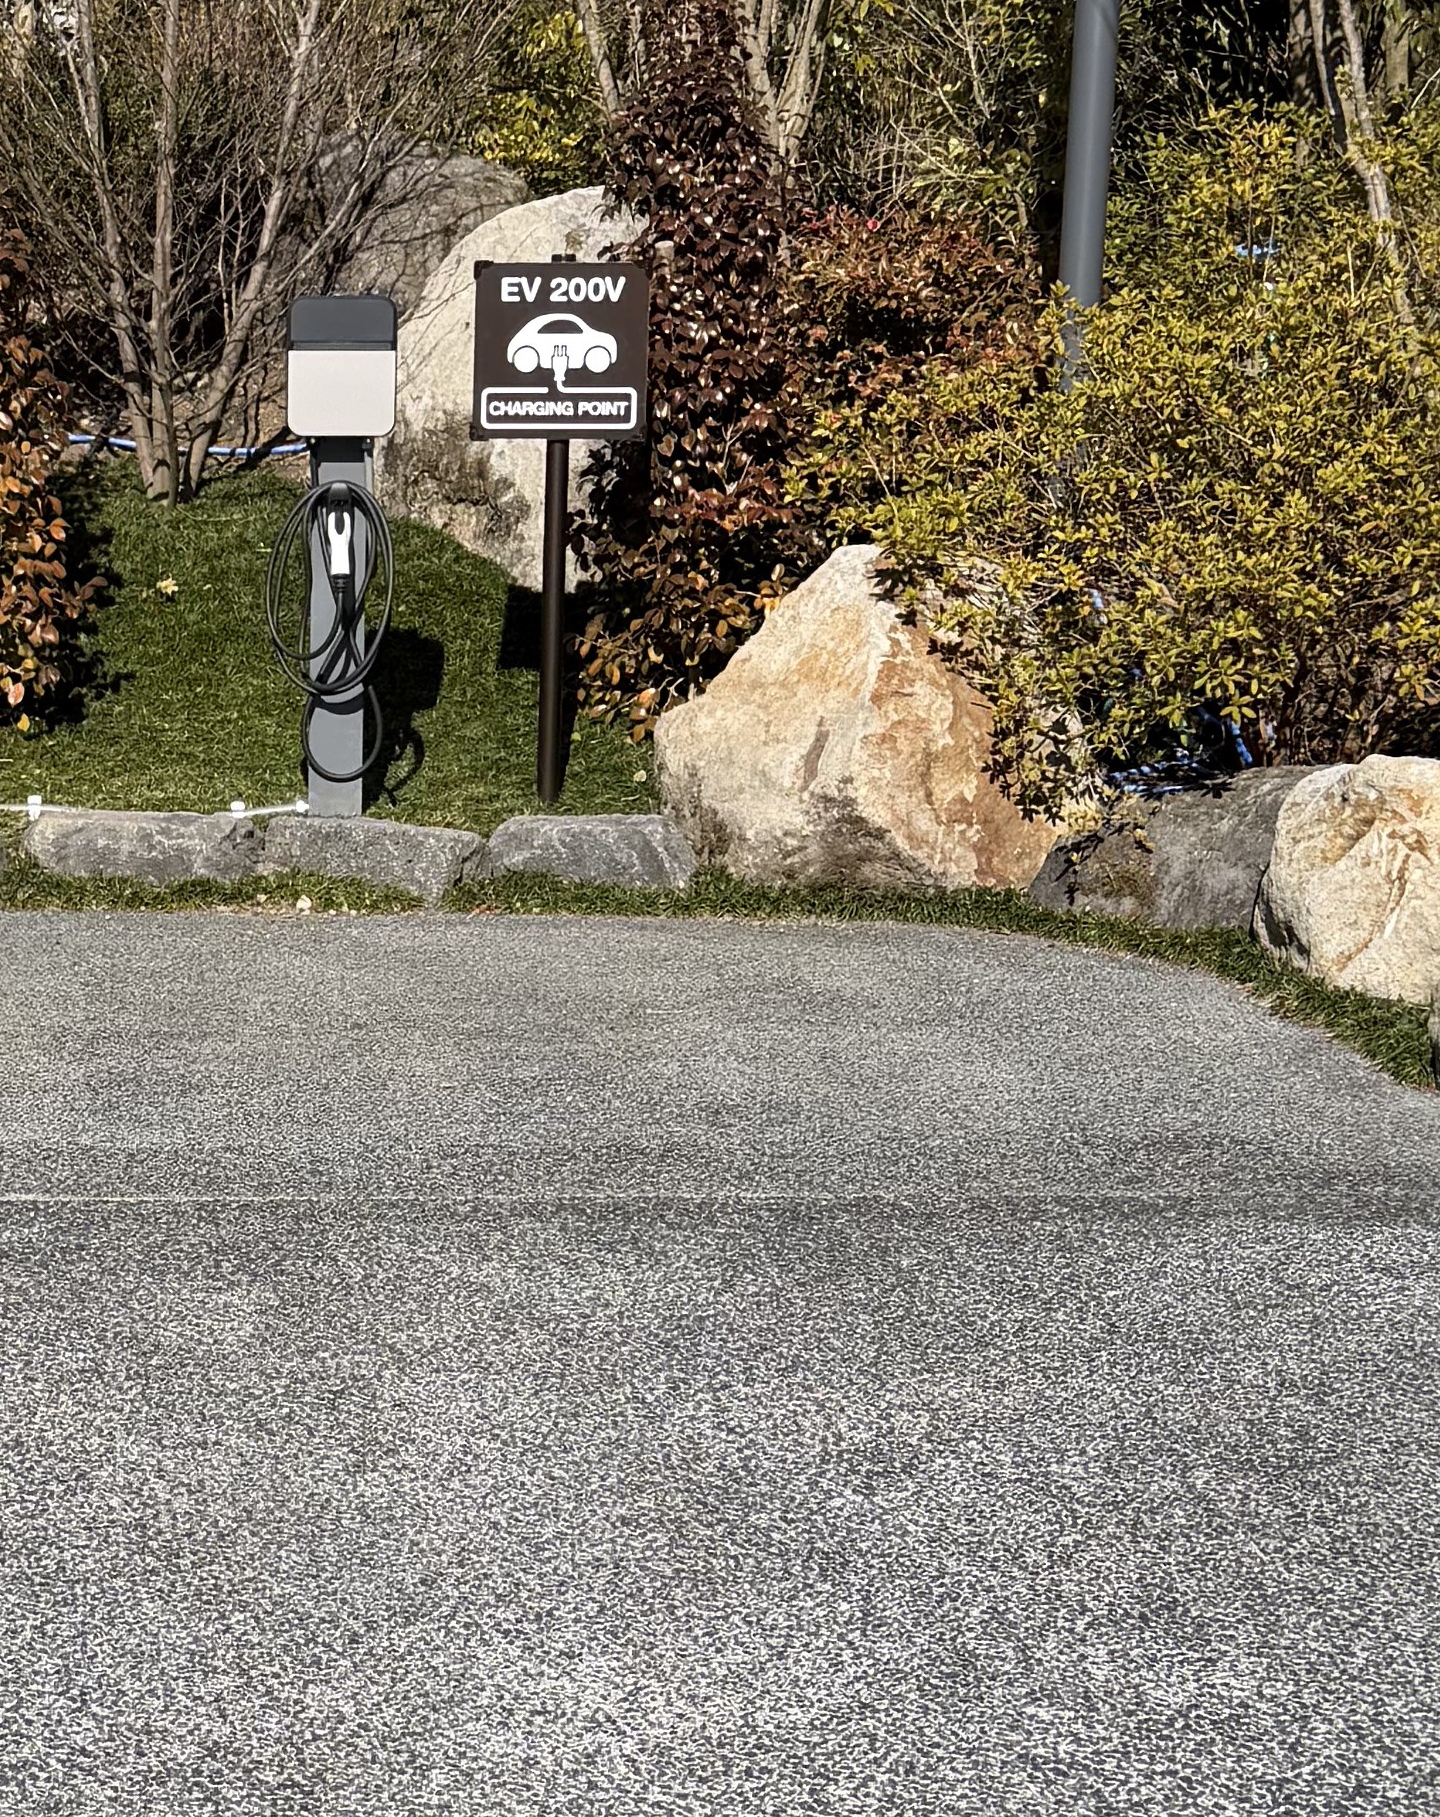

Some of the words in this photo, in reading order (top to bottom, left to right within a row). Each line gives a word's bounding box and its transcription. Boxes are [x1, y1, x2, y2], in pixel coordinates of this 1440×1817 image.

[501, 276, 542, 303] EV
[549, 276, 626, 303] 200V
[489, 400, 574, 416] CHARGING
[577, 400, 630, 417] POINT
